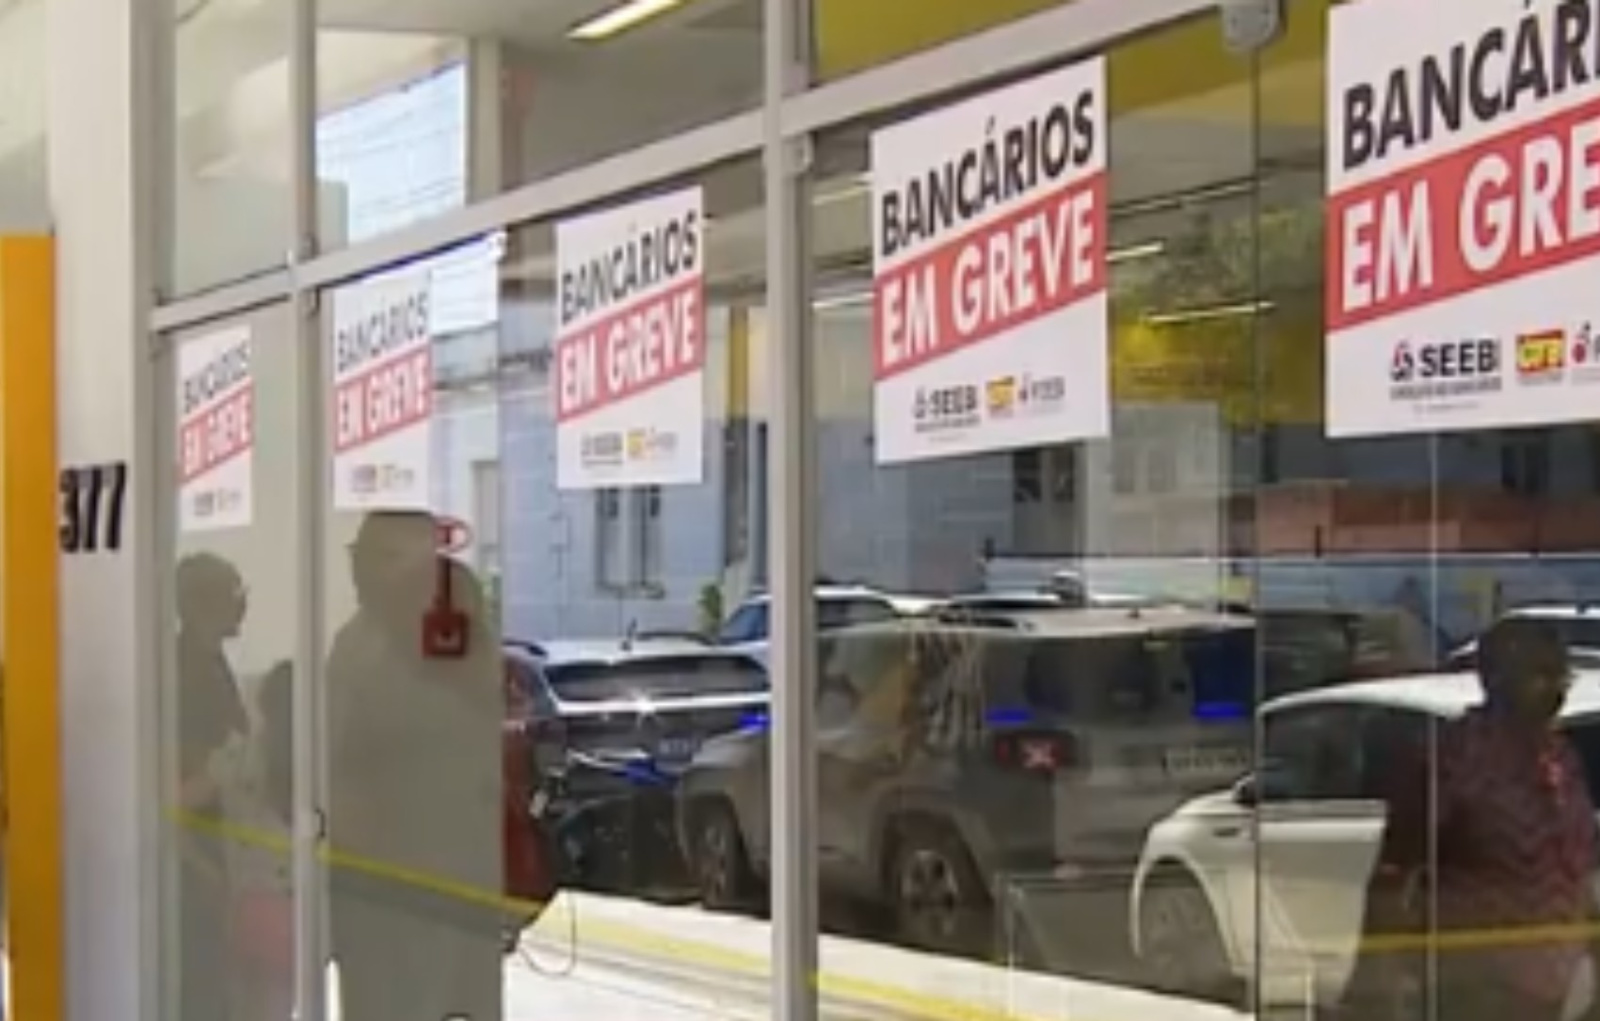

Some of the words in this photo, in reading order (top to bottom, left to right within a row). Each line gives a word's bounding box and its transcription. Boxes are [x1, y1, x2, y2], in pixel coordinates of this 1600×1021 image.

[881, 90, 1095, 257] BANCÁRIOS
[562, 208, 697, 326] BANCÁRIOS
[880, 268, 938, 368] EM
[951, 189, 1095, 336] GREVE
[1342, 179, 1433, 314] EM
[560, 331, 598, 411] EM
[607, 290, 695, 394] GREVE
[58, 461, 127, 553] 377
